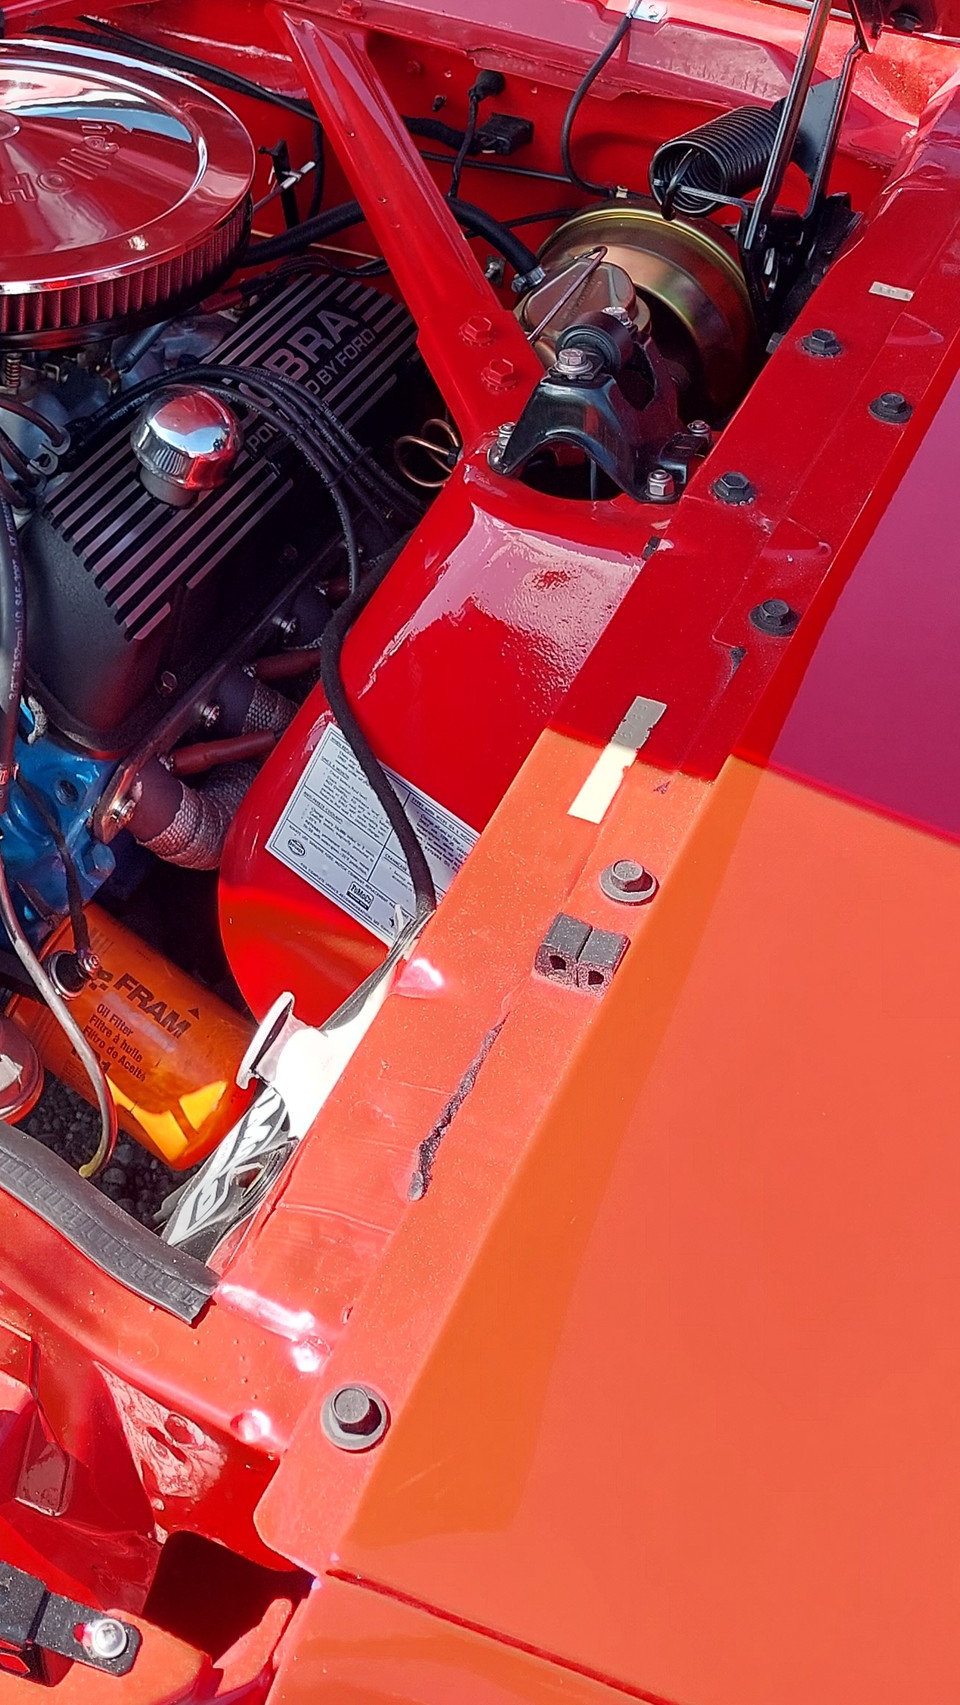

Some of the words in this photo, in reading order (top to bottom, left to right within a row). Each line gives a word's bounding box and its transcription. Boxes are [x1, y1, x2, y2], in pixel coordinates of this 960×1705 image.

[316, 361, 339, 385] BY
[335, 328, 376, 367] FORD
[96, 1003, 111, 1018] Oil
[109, 1014, 134, 1037] Filter
[113, 972, 191, 1039] FRAM
[83, 1025, 106, 1049] Filtro
[106, 1046, 118, 1060] de
[118, 1057, 146, 1082] Aceite
[89, 1014, 113, 1037] Filtre
[120, 1037, 144, 1064] huile
